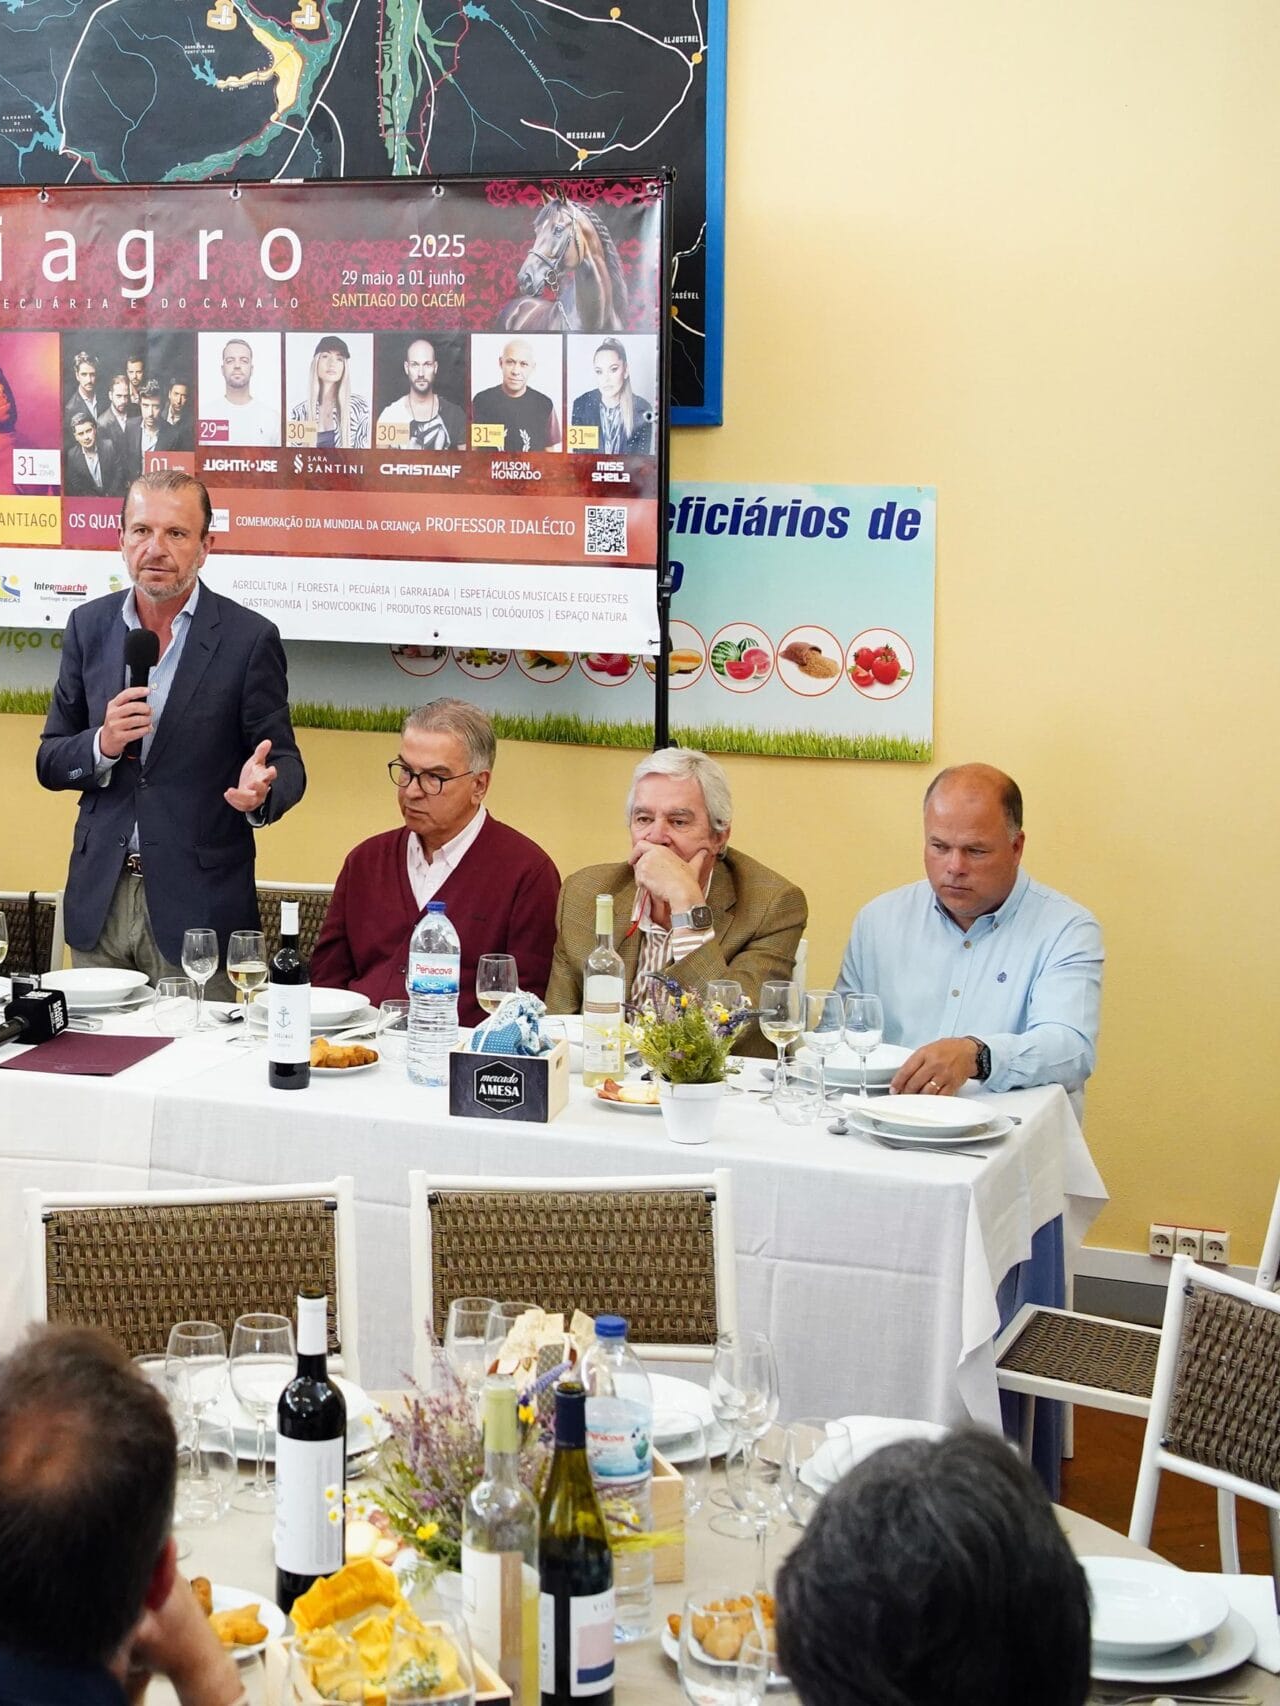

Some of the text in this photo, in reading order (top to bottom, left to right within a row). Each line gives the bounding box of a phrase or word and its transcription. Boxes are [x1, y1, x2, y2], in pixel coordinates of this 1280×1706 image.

[663, 35, 700, 44] ALJUSTREL
[566, 131, 606, 140] MESSEJANA
[408, 233, 466, 258] 2025
[342, 269, 466, 288] 29 maio a 01 junho
[130, 299, 138, 310] E
[161, 298, 187, 310] DO
[203, 297, 300, 309] CAVALO
[332, 290, 466, 308] SANTIAGO DO CACÉM
[200, 421, 217, 438] 29
[288, 423, 305, 439] 30
[378, 424, 396, 441] 30
[473, 426, 490, 443] 31
[569, 428, 586, 444] 31
[17, 455, 37, 476] 31
[307, 463, 365, 474] SANTINI
[491, 461, 531, 471] WILSON
[491, 470, 542, 481] HONRADO
[69, 513, 86, 528] OS
[235, 515, 576, 536] COMEMORAÇÃO DIA MUNDIAL DA CRIANÇA PROFESSOR IDALÉCIO
[668, 496, 922, 541] ficiários de
[34, 581, 88, 593] Intermarché
[232, 580, 629, 604] AGRICULTURA FLORESTA PECUÁRIA GARRAIADA ESPETÁCULOS MUSICAIS E EQUESTRES
[242, 598, 628, 622] GASTRONOMIA SHOWCOOKING PRODUTOS REGIONAIS COLÓQUIOS ESPAÇO NATURA
[415, 963, 453, 975] Penacova
[480, 1072, 519, 1084] mercado
